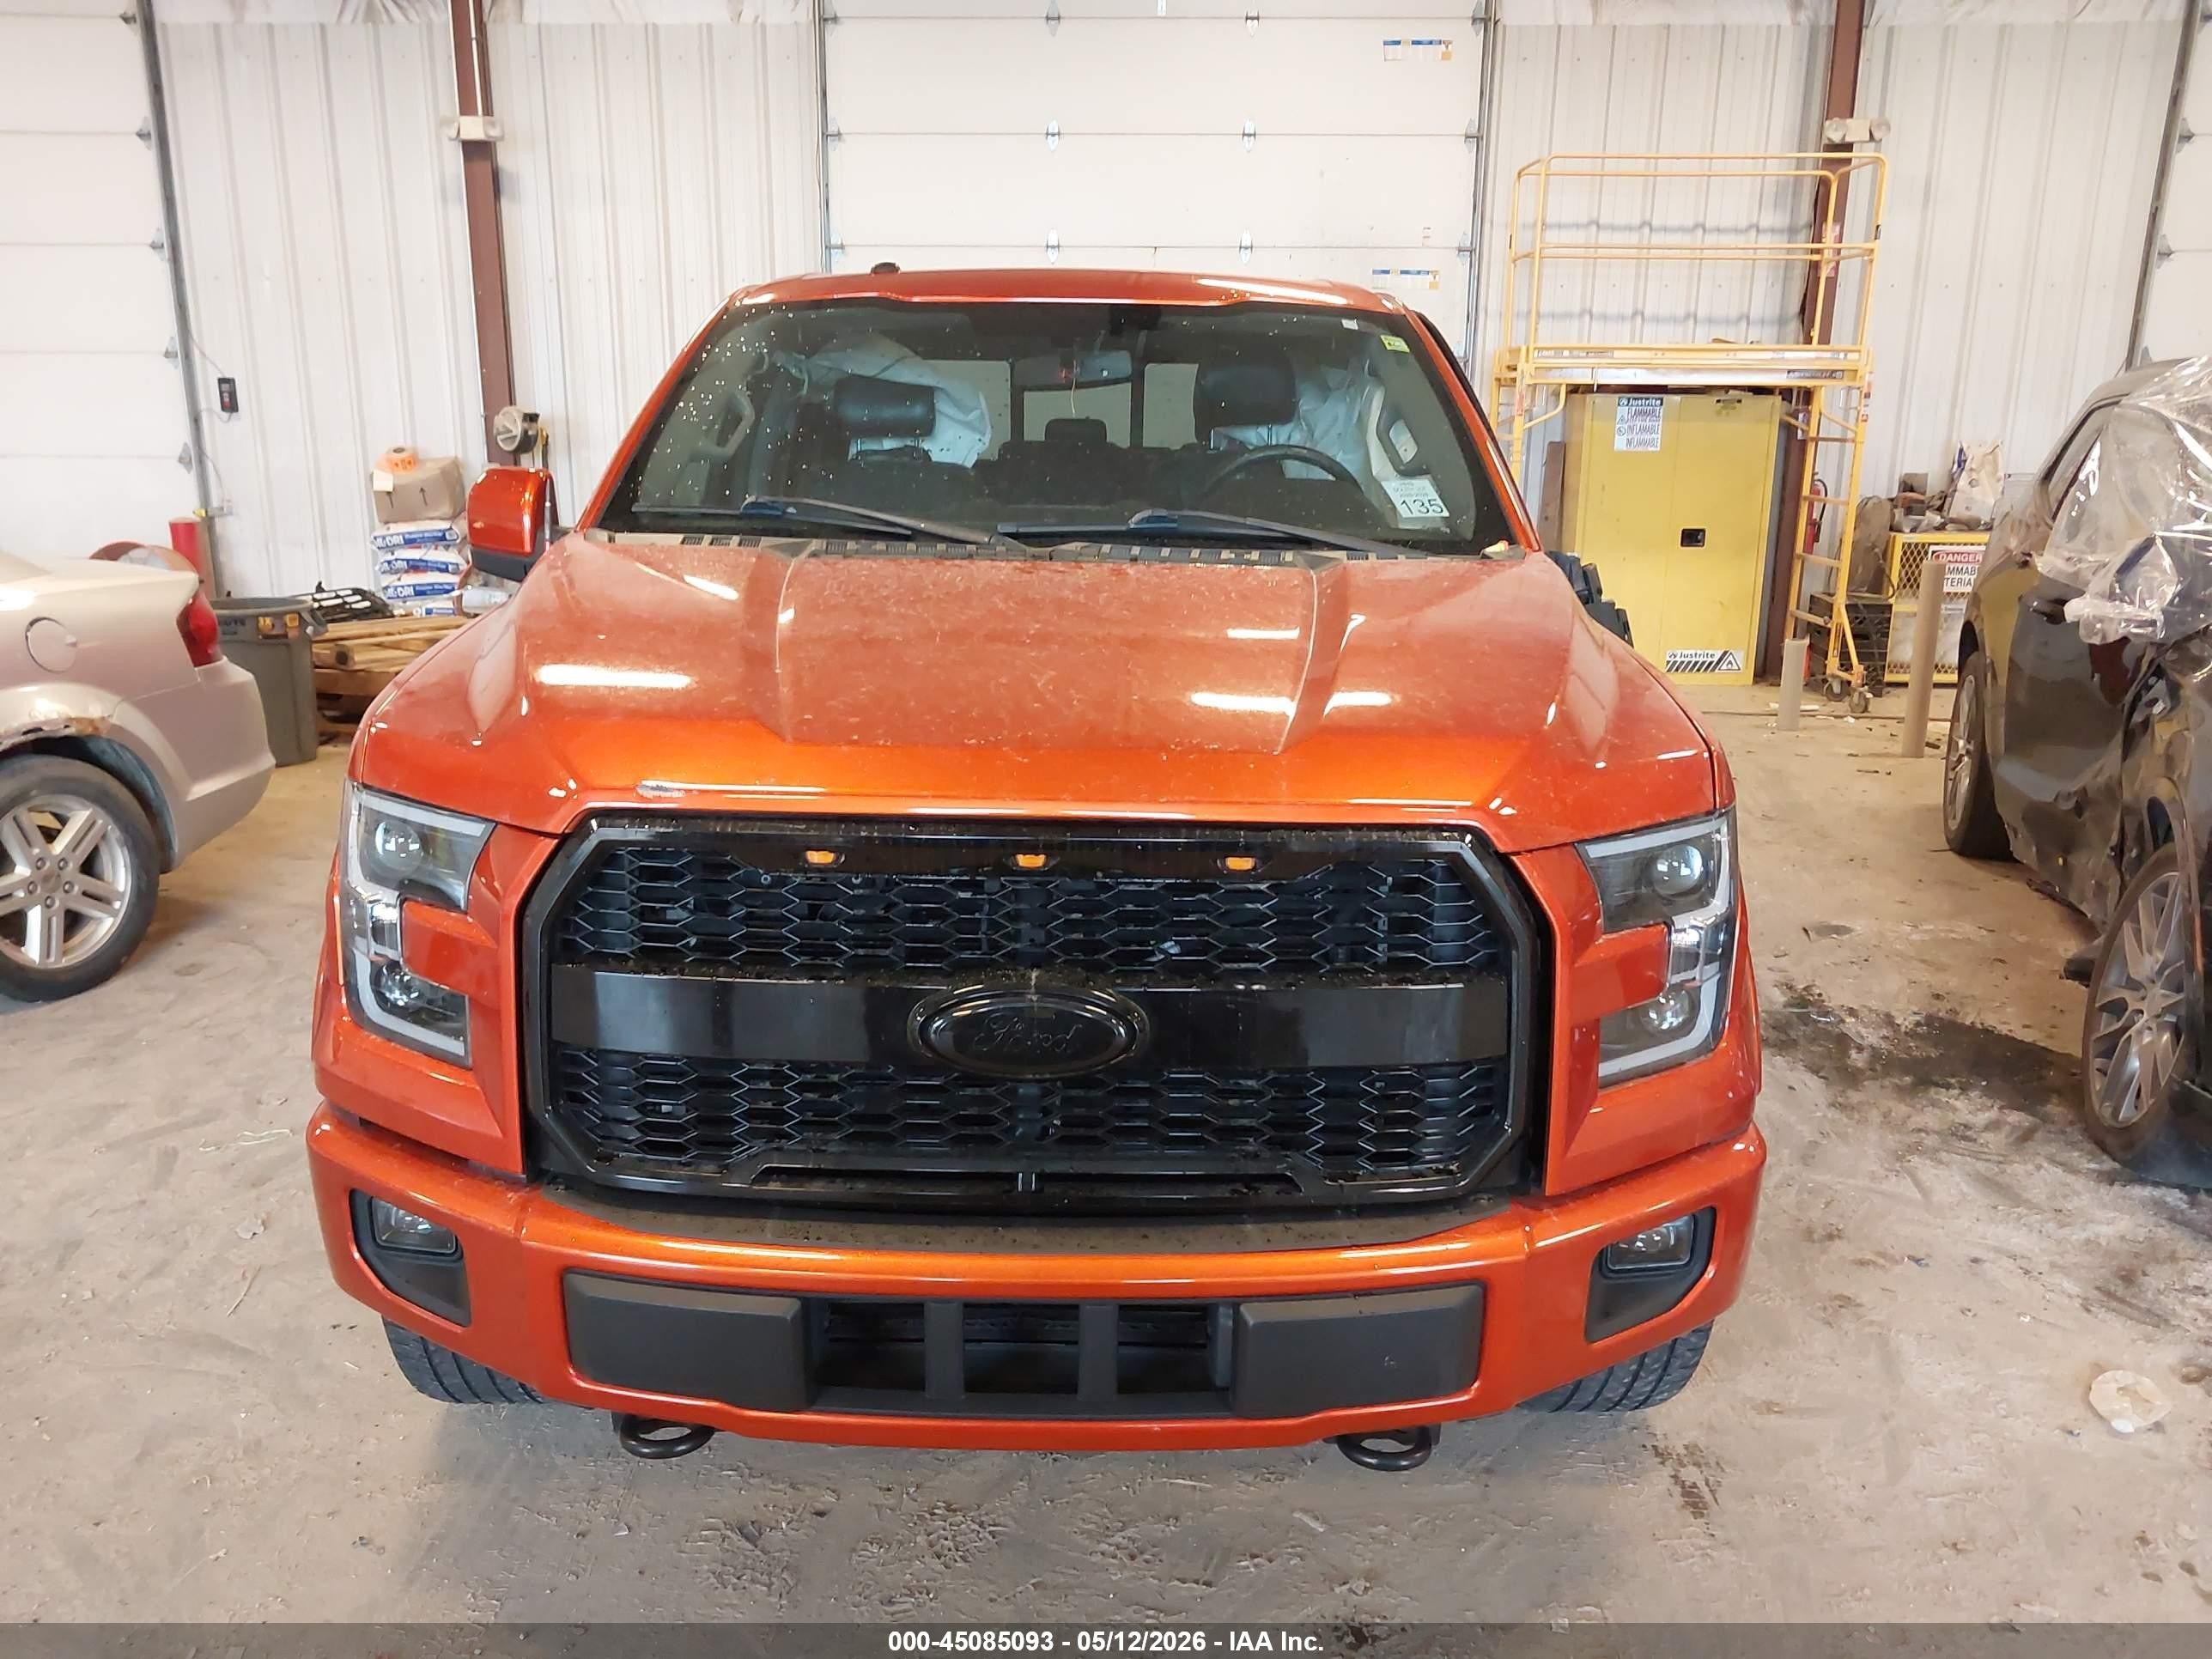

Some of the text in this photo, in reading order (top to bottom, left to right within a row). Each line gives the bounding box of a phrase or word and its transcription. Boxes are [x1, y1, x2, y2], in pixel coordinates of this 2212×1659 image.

[1401, 499, 1443, 514] 135
[1944, 577, 1972, 587] TERIA
[1679, 651, 1716, 659] Justrite
[973, 1012, 1084, 1053] Ford
